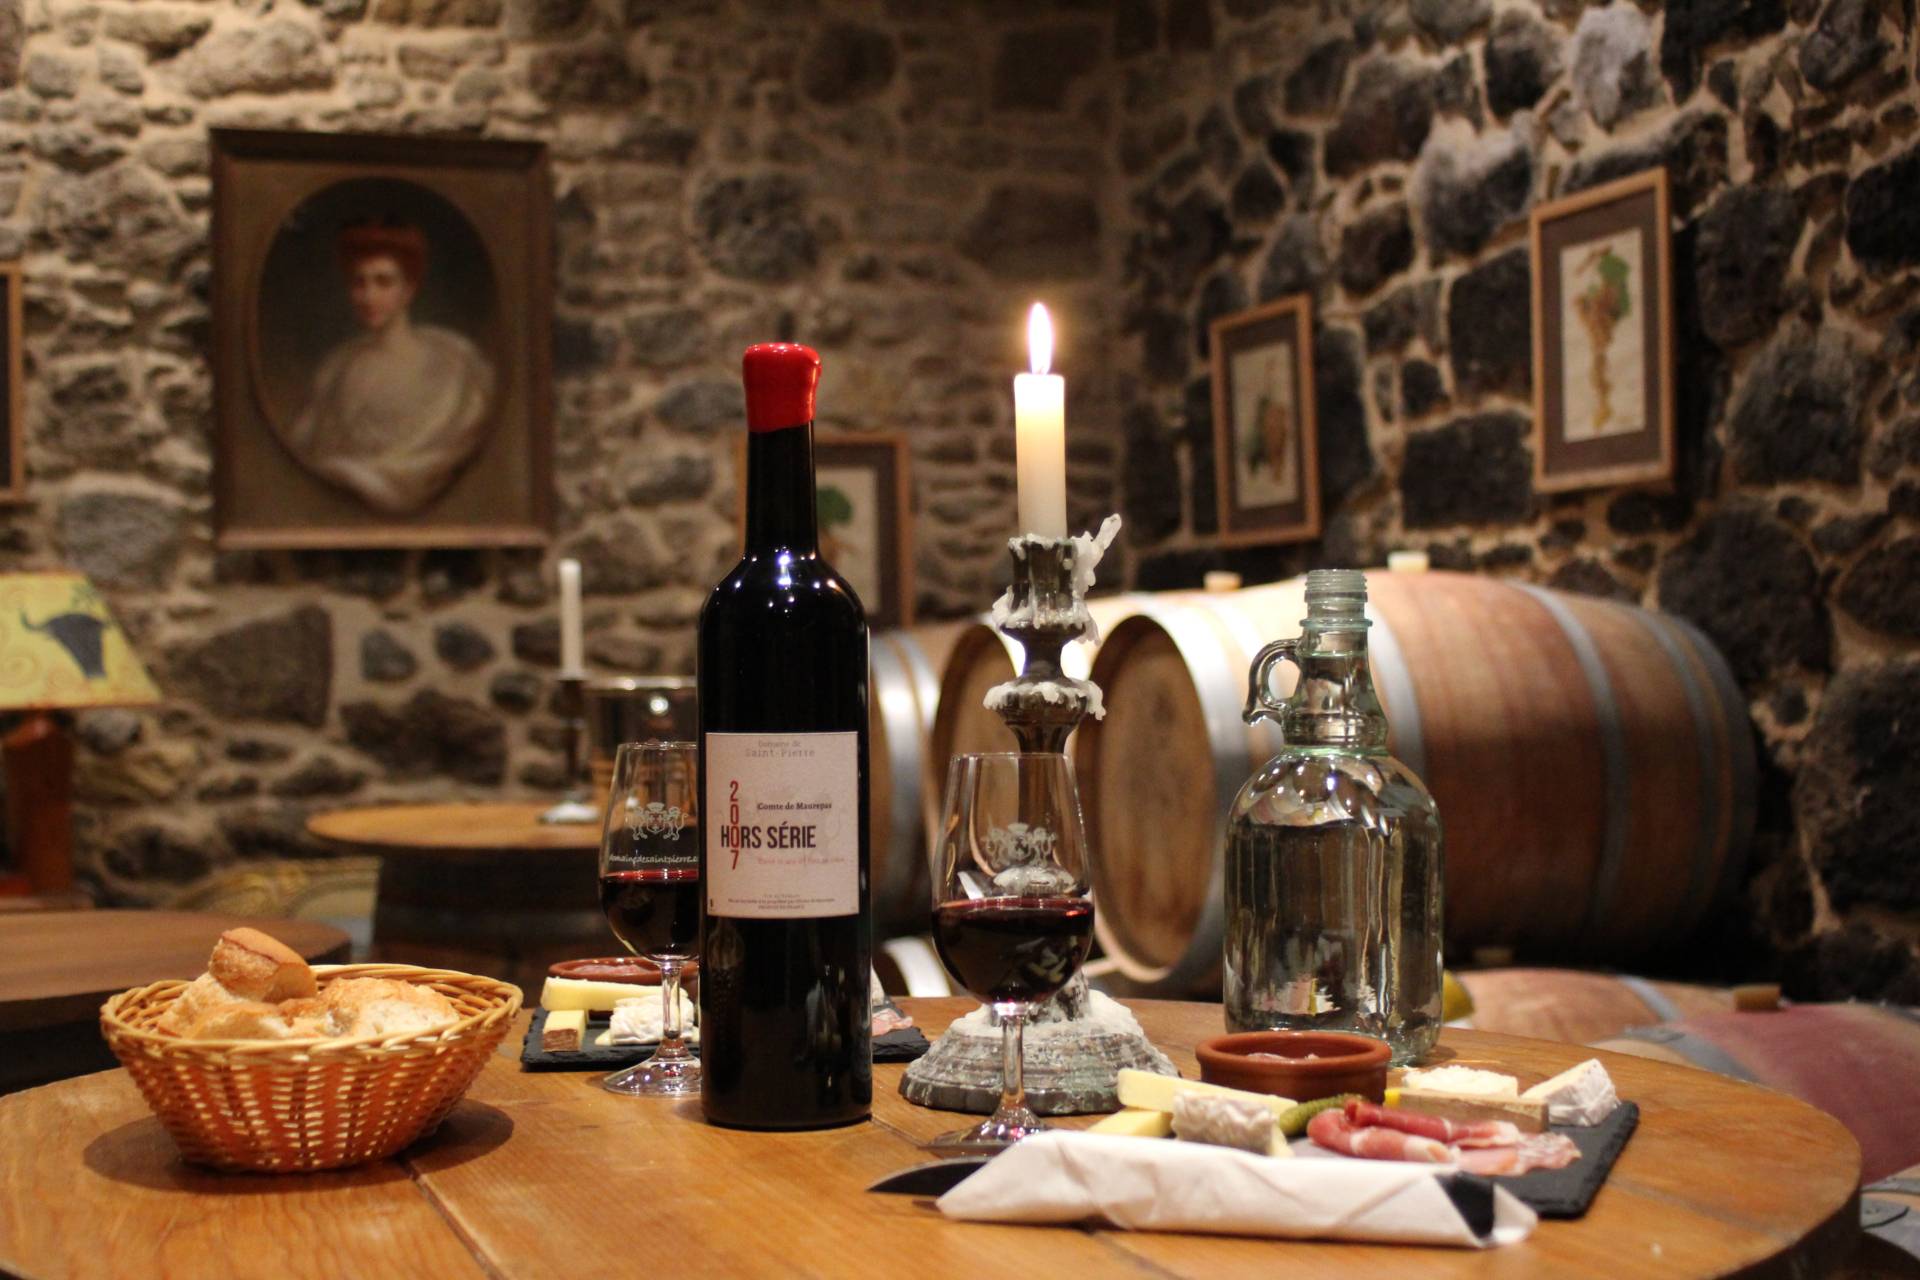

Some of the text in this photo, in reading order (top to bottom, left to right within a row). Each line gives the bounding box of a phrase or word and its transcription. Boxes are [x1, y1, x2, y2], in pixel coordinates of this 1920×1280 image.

[745, 748, 816, 758] Saint-Pierre
[757, 802, 784, 811] Comte
[785, 801, 795, 811] de
[720, 821, 817, 849] HORS SÉRIE
